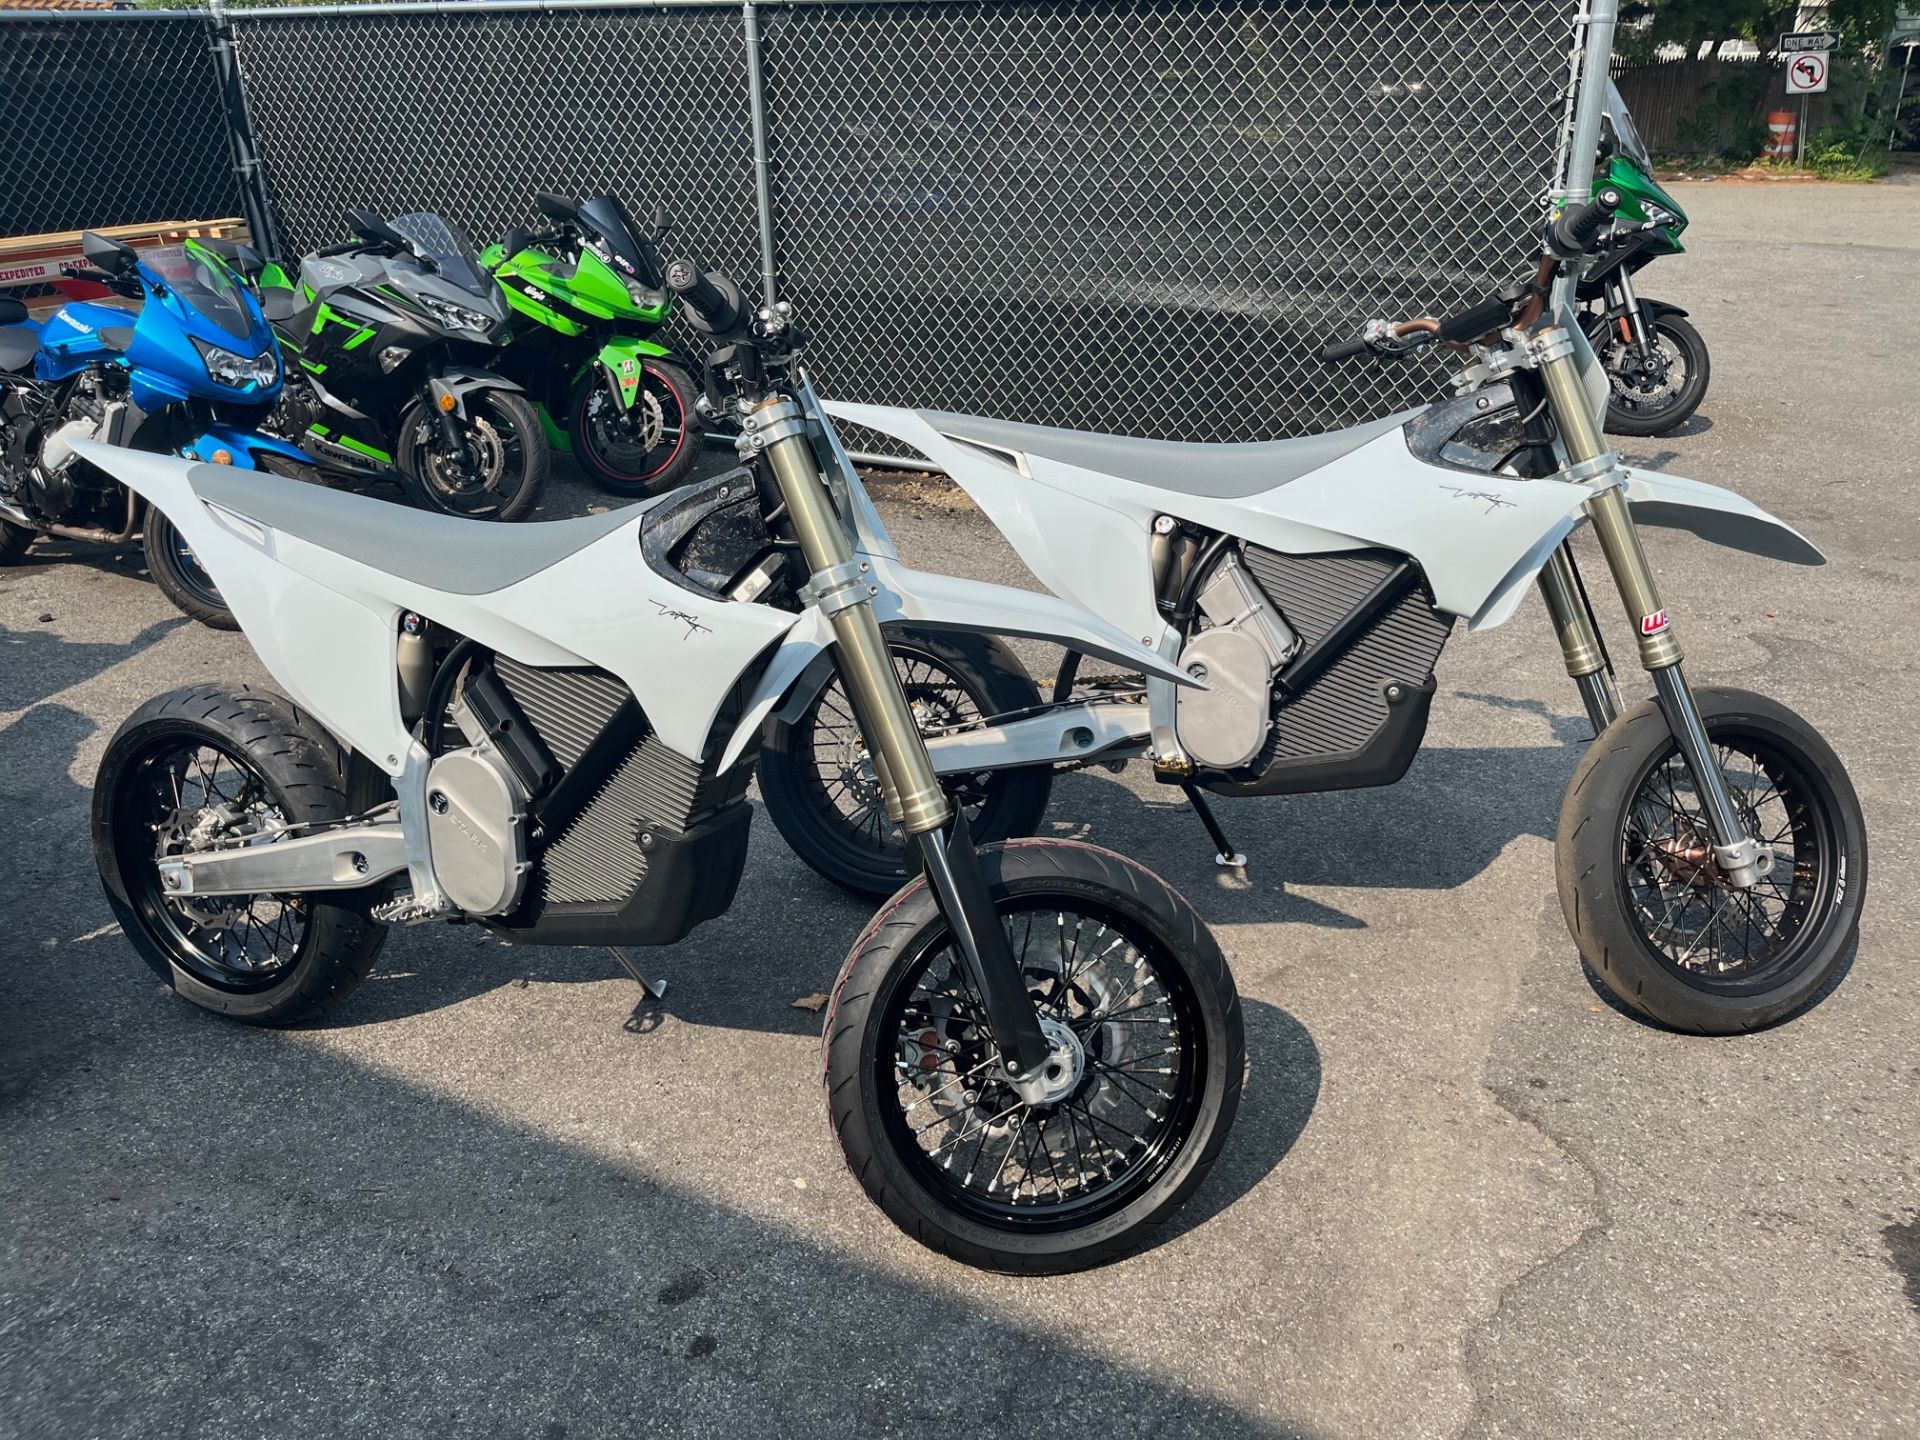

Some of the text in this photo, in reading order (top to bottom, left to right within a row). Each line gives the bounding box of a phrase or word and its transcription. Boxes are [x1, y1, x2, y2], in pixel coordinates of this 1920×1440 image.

[1786, 37, 1825, 47] ONE WAY
[56, 309, 93, 334] Kawasaki
[621, 376, 638, 387] 3M
[313, 440, 377, 471] Kawasaki
[448, 813, 489, 854] STARK
